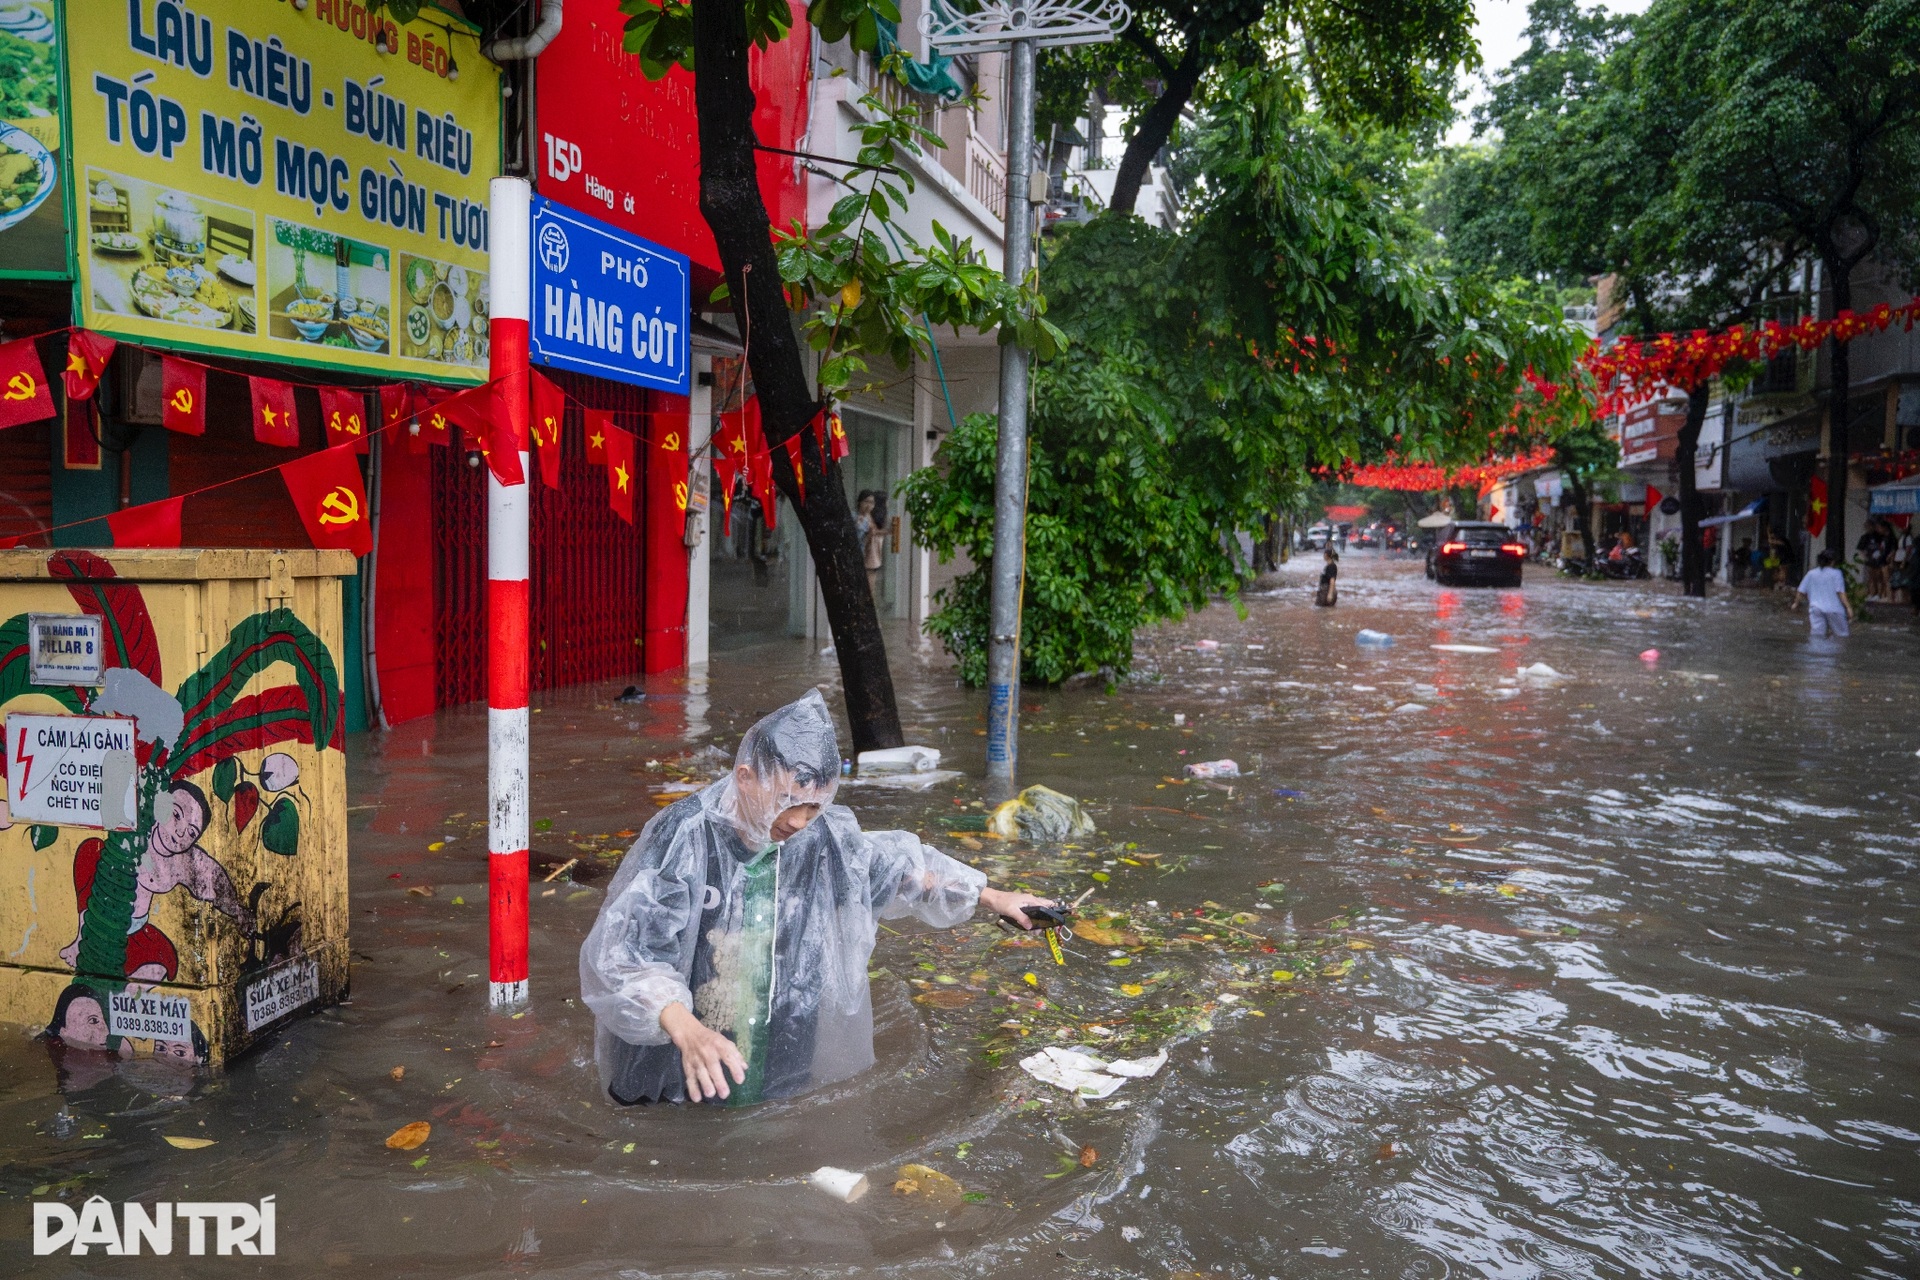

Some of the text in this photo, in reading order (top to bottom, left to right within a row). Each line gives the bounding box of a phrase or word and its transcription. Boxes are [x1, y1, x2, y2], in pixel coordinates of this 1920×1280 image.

[407, 33, 448, 78] BÉO
[228, 30, 311, 114] RIÊU
[346, 77, 406, 150] BÚN
[417, 110, 471, 175] RIÊU
[95, 73, 186, 159] TÓP
[202, 116, 262, 185] MỠ
[276, 139, 350, 216] MỌC
[360, 159, 426, 233] GIÒN
[544, 132, 582, 182] 15D
[585, 173, 614, 210] Hàng
[601, 251, 650, 288] PHỐ
[544, 278, 678, 367] HÀNG CÓT
[52, 624, 73, 636] HÀNG
[75, 625, 88, 636] MÃ
[90, 627, 94, 636] 1
[39, 640, 93, 655] PILLAR 8
[38, 726, 67, 748] CẤM
[70, 731, 90, 753] LẠI
[59, 761, 103, 780] CÓ ĐIỆ
[51, 779, 84, 793] NGUY
[276, 976, 290, 994] XE
[140, 999, 156, 1015] XE
[160, 999, 187, 1018] MÁY
[116, 1016, 184, 1036] 0389.8383.91
